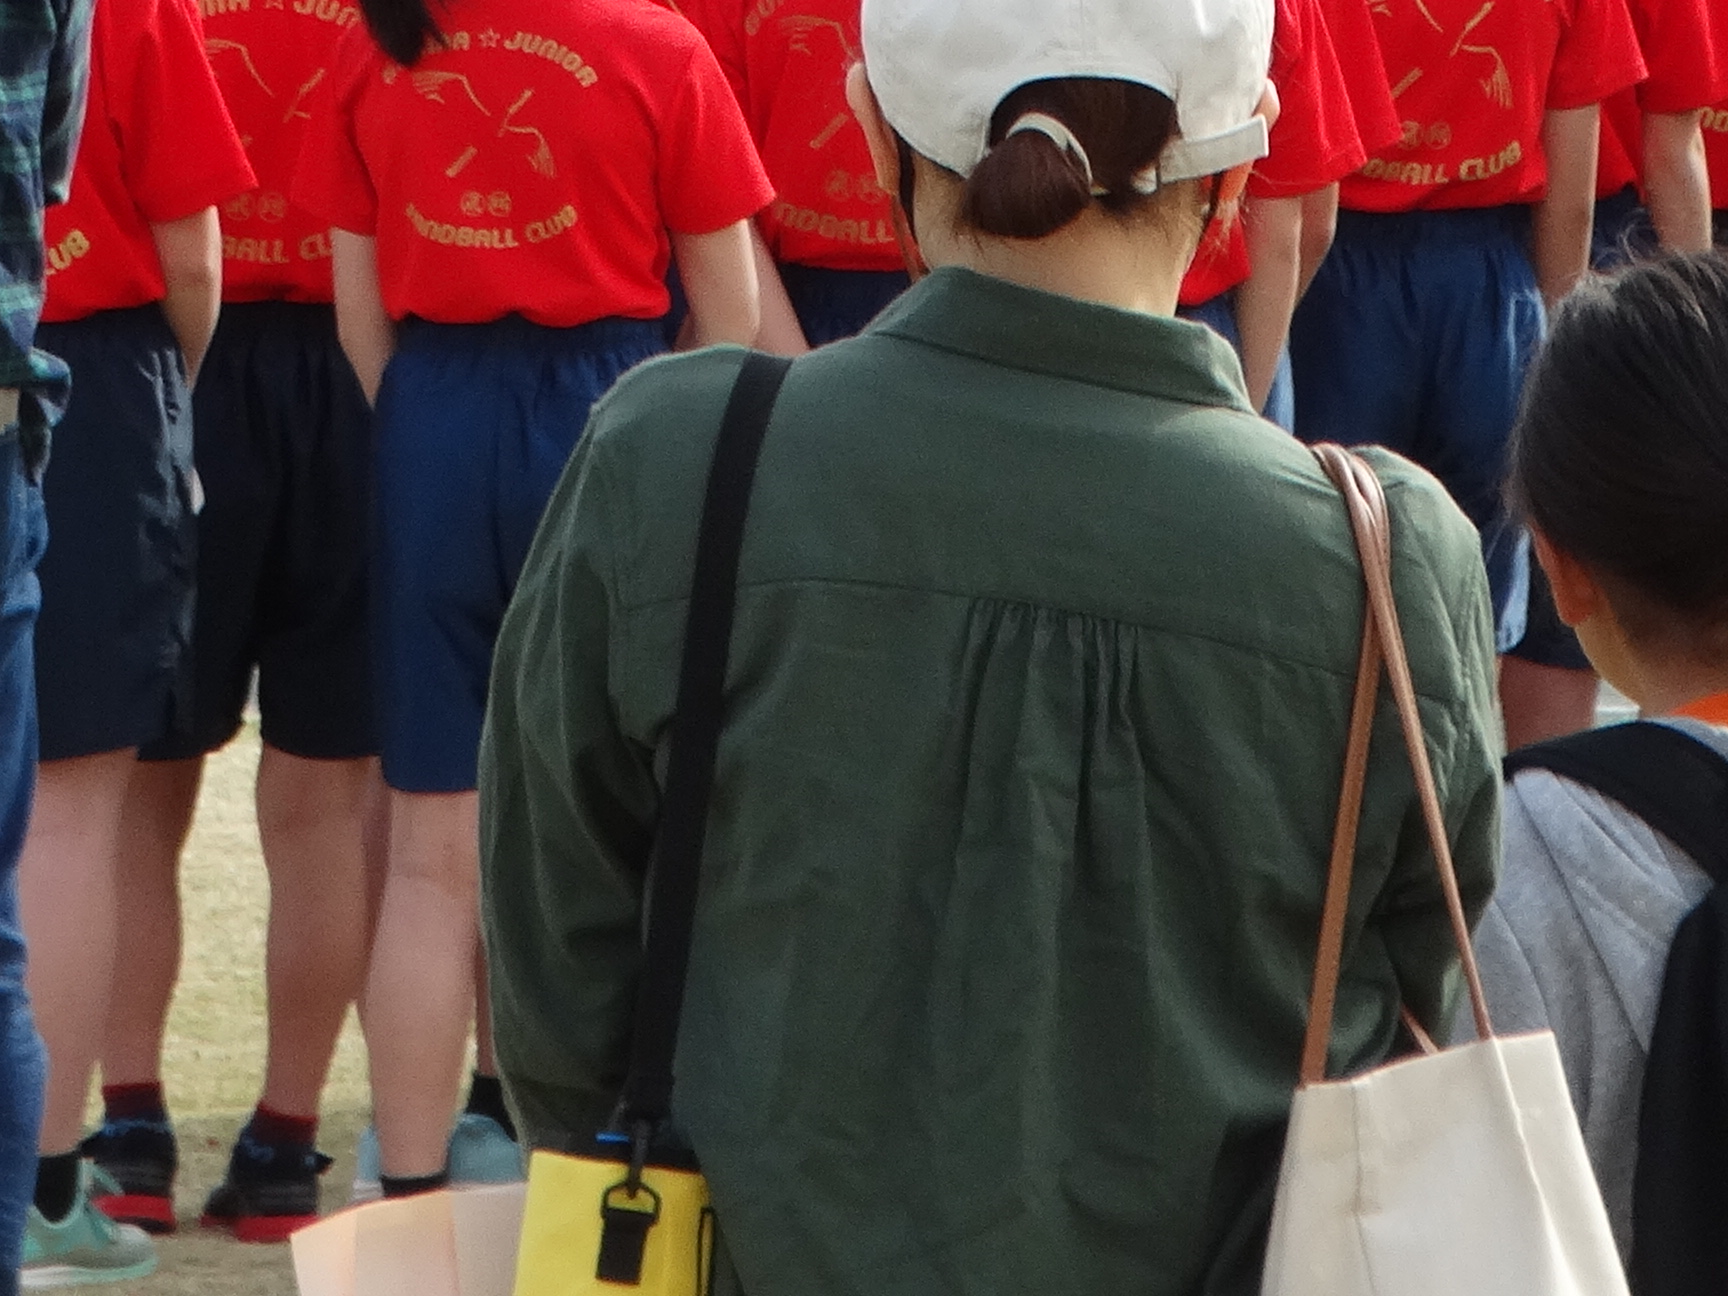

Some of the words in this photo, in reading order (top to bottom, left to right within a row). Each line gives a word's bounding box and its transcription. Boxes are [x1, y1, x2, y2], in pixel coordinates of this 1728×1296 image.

[503, 30, 599, 88] JUNIOR
[1363, 158, 1449, 186] DBALL
[1458, 140, 1522, 181] CLUB
[524, 204, 579, 245] CLUB
[774, 203, 894, 245] NDBALL
